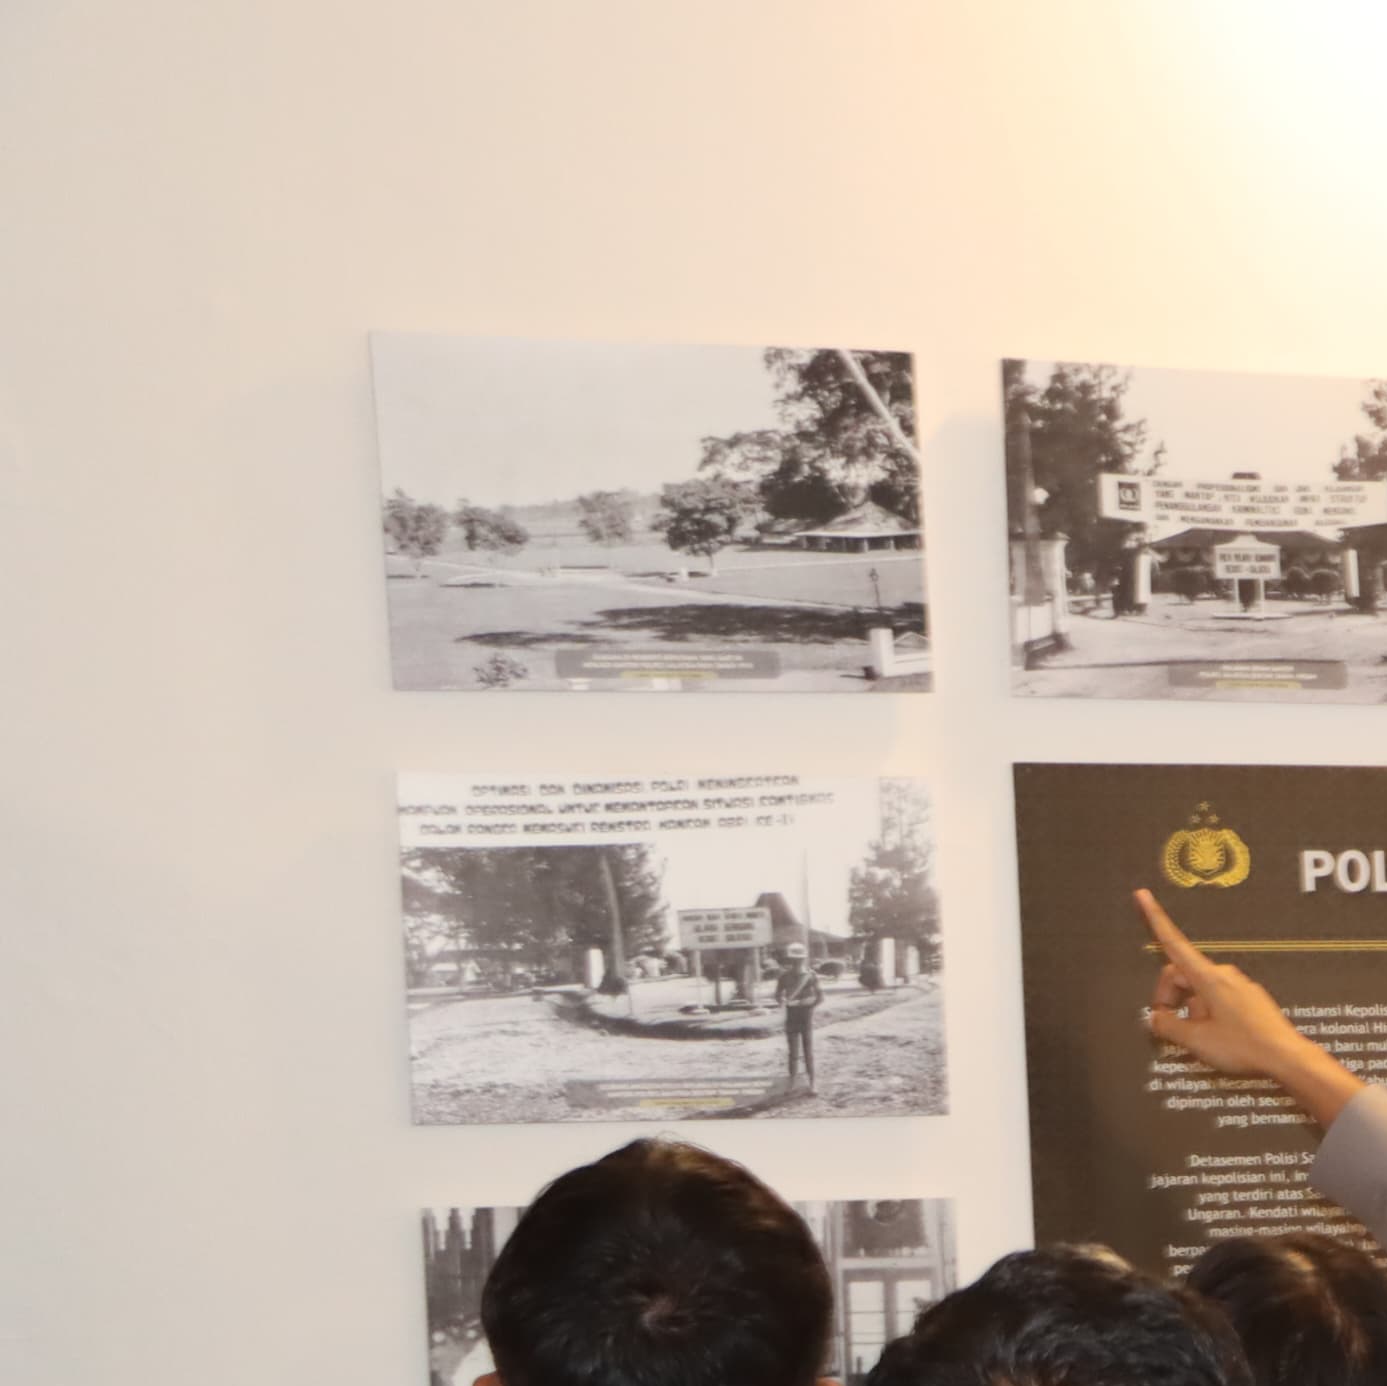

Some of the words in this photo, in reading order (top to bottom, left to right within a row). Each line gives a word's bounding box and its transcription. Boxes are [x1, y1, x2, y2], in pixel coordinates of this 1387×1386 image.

[1293, 1004, 1341, 1016] instansi
[1320, 1021, 1369, 1034] kolonial
[1335, 1038, 1363, 1051] baru
[1167, 1095, 1223, 1110] dipimpin
[1227, 1094, 1254, 1107] oleh
[1217, 1114, 1248, 1128] yang
[1265, 1152, 1297, 1165] Polisi
[1152, 1171, 1197, 1188] jajaran
[1199, 1191, 1228, 1204] yang
[1233, 1187, 1272, 1200] terdiri
[1277, 1187, 1303, 1199] atas
[1250, 1205, 1297, 1218] Kendati
